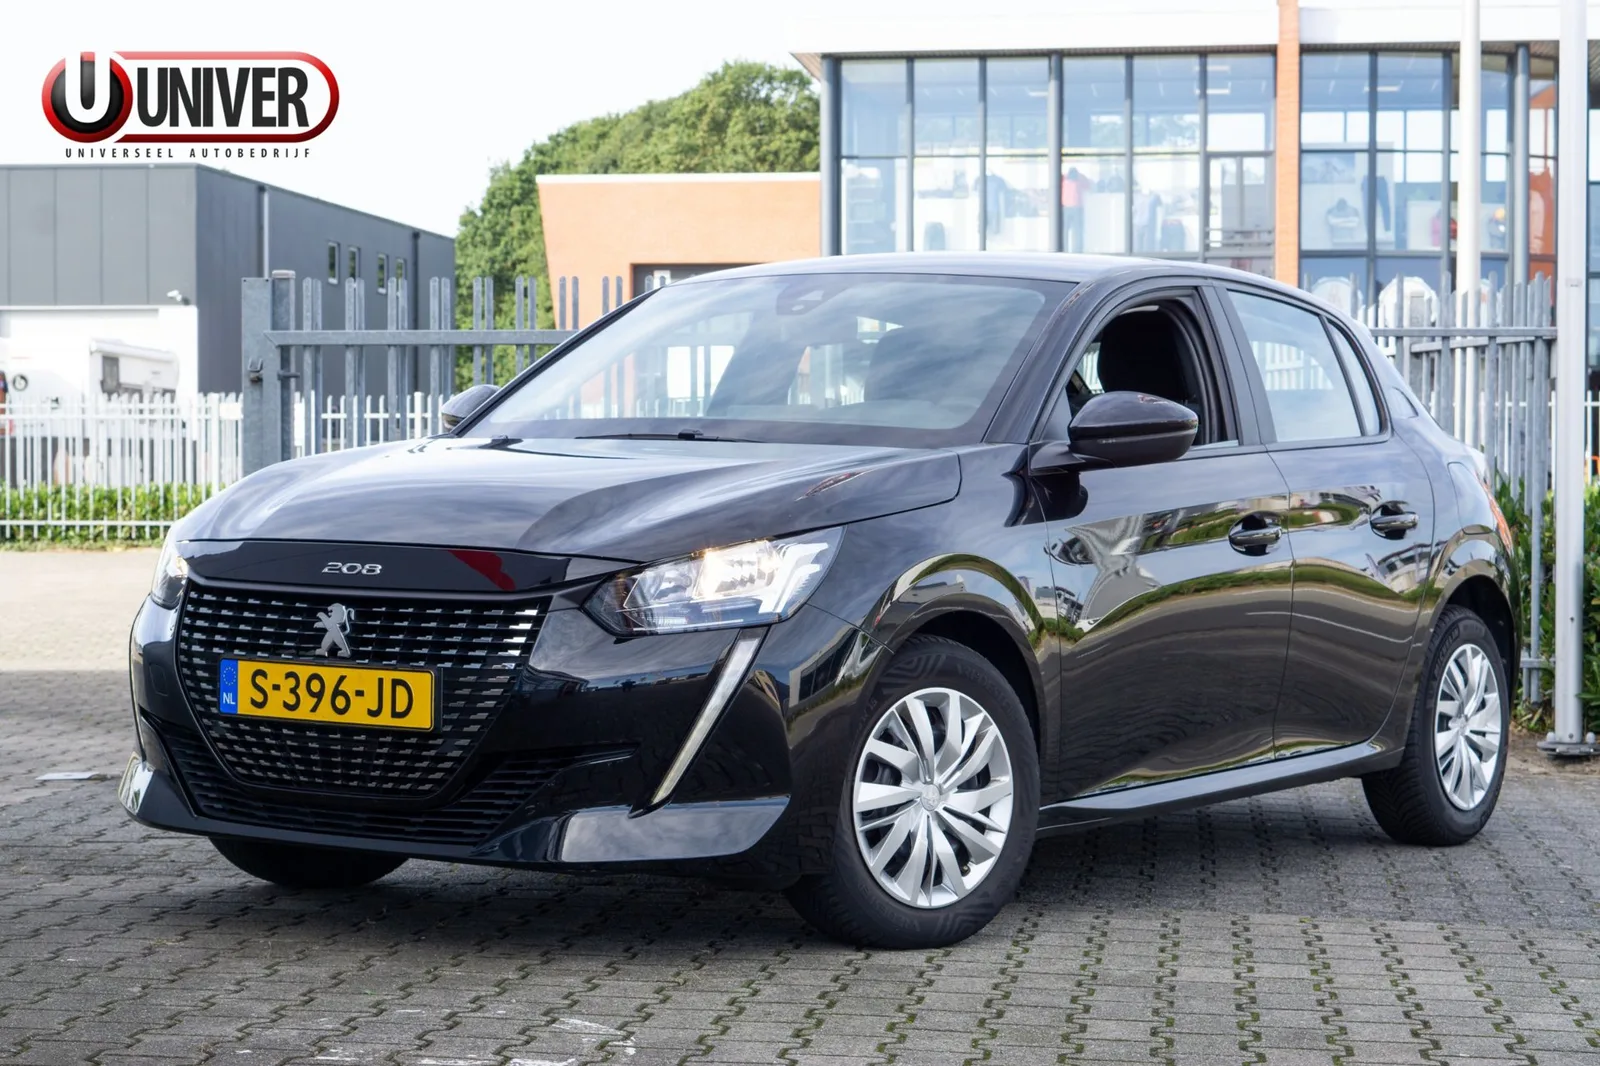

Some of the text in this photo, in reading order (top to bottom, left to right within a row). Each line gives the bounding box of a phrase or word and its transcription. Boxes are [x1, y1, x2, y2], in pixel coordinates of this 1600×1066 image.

[321, 561, 382, 576] 208
[222, 692, 236, 705] NL
[250, 668, 414, 719] S-396-JD
